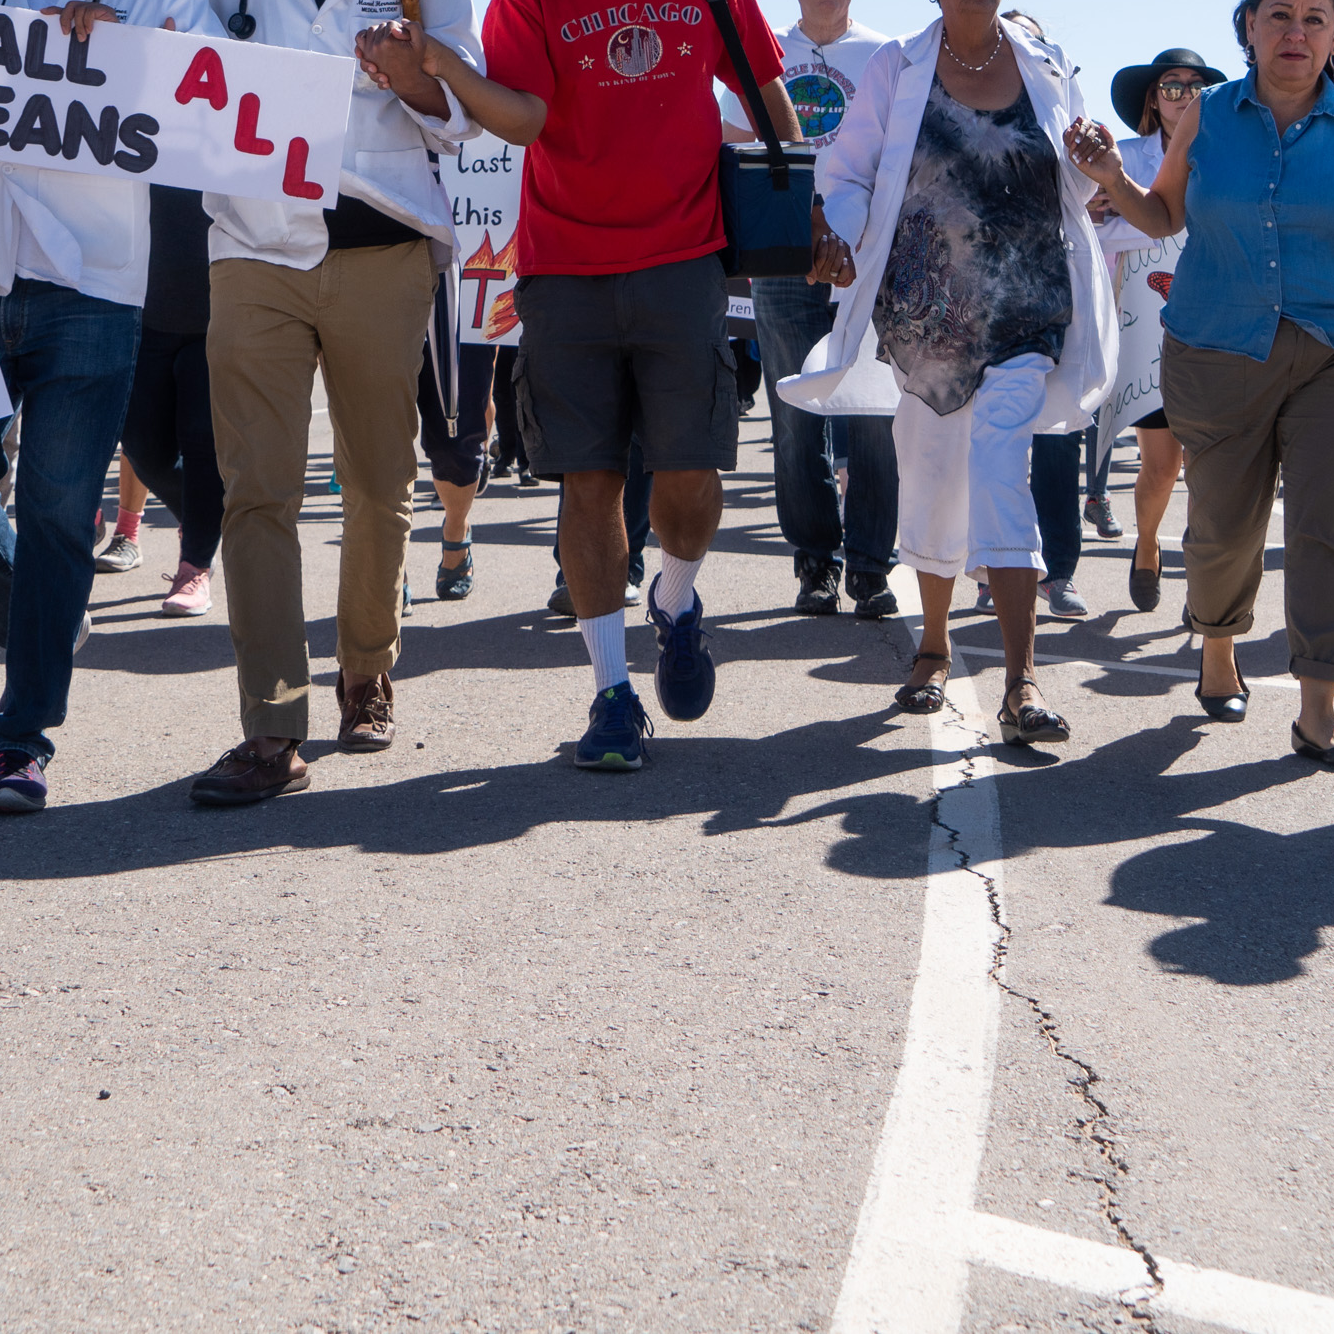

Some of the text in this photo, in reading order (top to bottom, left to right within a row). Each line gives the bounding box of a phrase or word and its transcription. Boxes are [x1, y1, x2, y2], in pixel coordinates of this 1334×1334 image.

[560, 2, 702, 43] CHICAGO
[613, 77, 636, 86] KIND
[652, 71, 676, 80] TOWN
[811, 63, 857, 101] YOURSEL
[793, 104, 811, 112] IFT
[174, 46, 324, 201] ALL
[813, 127, 841, 149] BLO
[457, 141, 512, 174] last
[452, 196, 502, 226] this
[730, 304, 751, 315] ren
